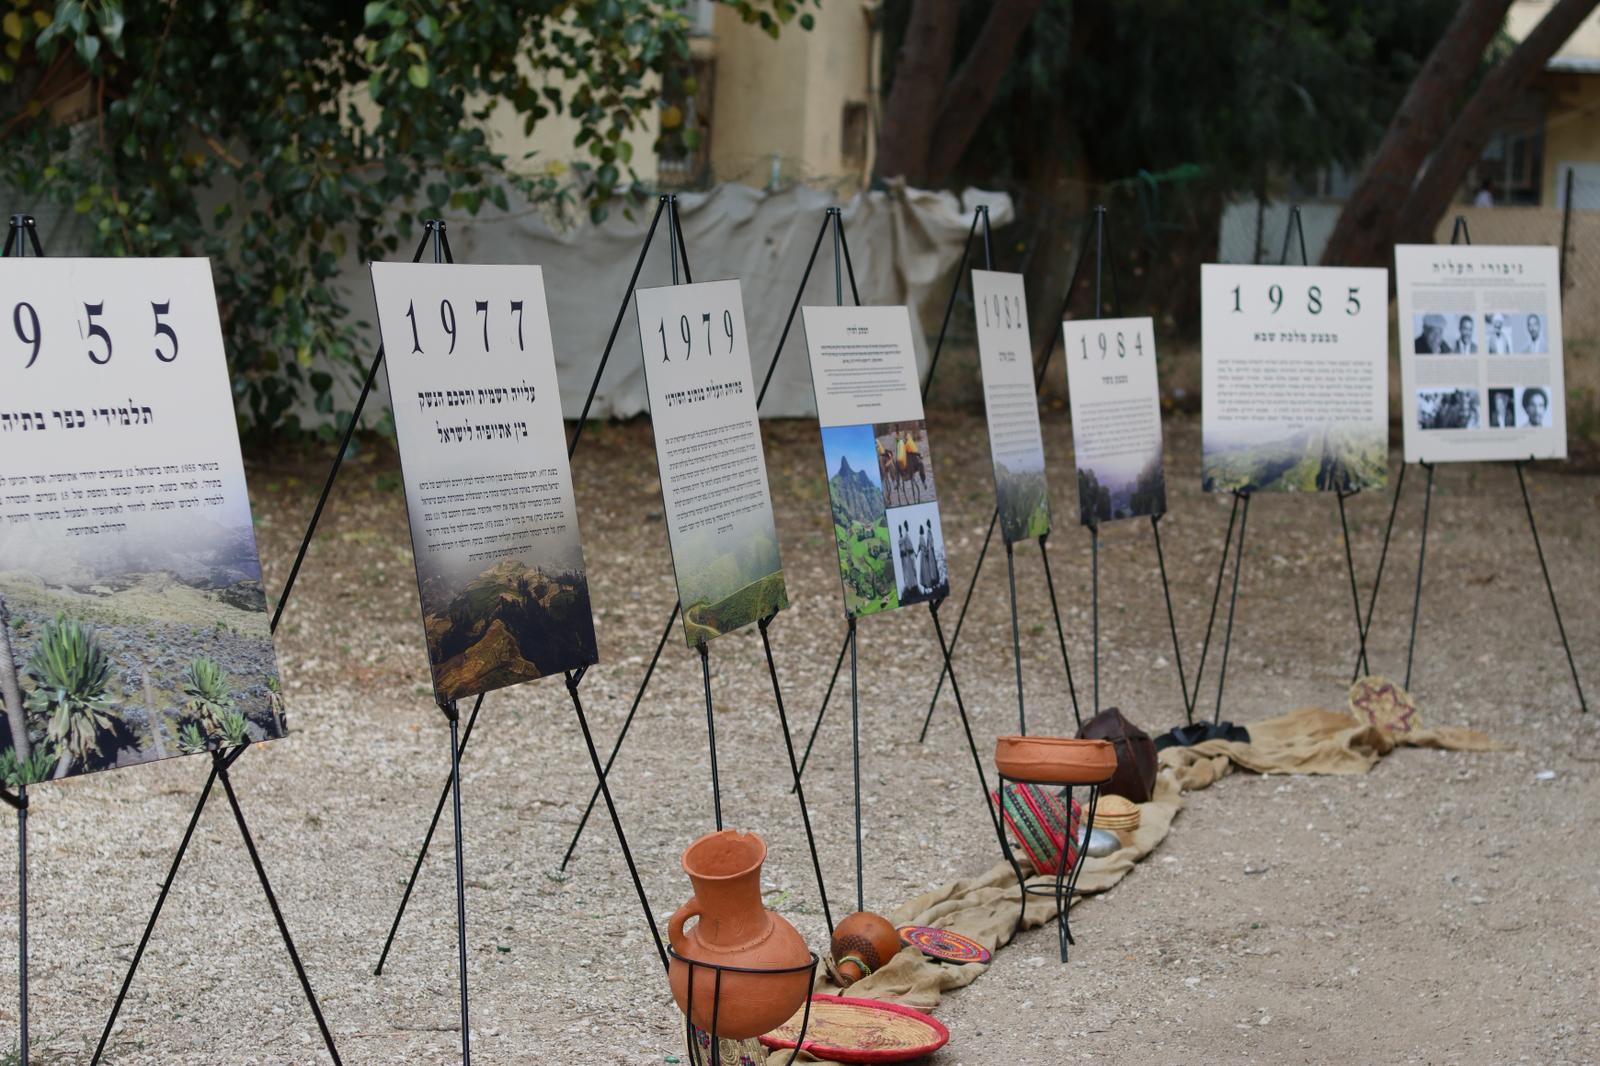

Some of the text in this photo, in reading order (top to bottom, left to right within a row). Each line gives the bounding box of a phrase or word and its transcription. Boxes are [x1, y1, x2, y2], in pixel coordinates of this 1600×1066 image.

[1231, 284, 1361, 316] 1985
[406, 298, 525, 355] 1977
[658, 309, 734, 363] 1979
[1080, 331, 1143, 359] 1984
[418, 380, 536, 413] עלייה רשמית והסכם הנשק
[1, 398, 153, 432] תלמידי כפר בתיה
[436, 418, 528, 443] בין אתיופיה לישראל
